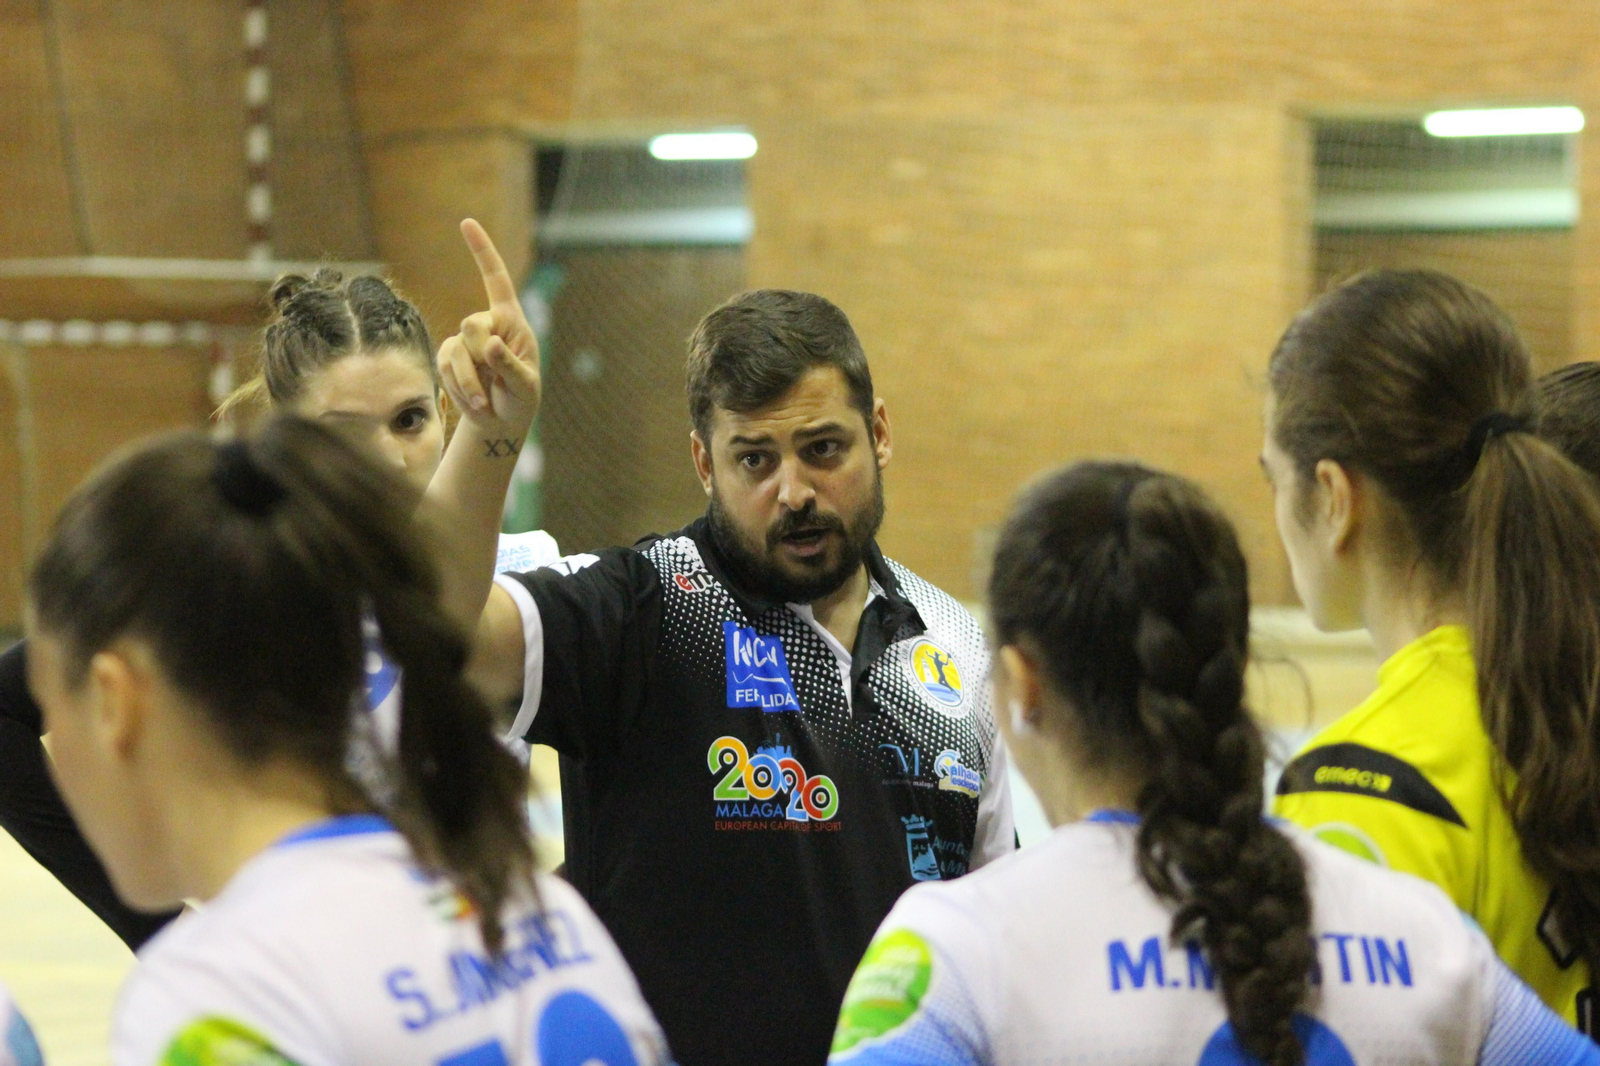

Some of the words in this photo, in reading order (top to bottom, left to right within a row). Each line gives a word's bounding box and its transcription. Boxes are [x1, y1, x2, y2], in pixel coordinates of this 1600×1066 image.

[707, 735, 839, 822] 2020
[716, 803, 784, 818] MALAGA
[714, 821, 768, 832] EUROPEAN
[814, 821, 842, 832] SPORT
